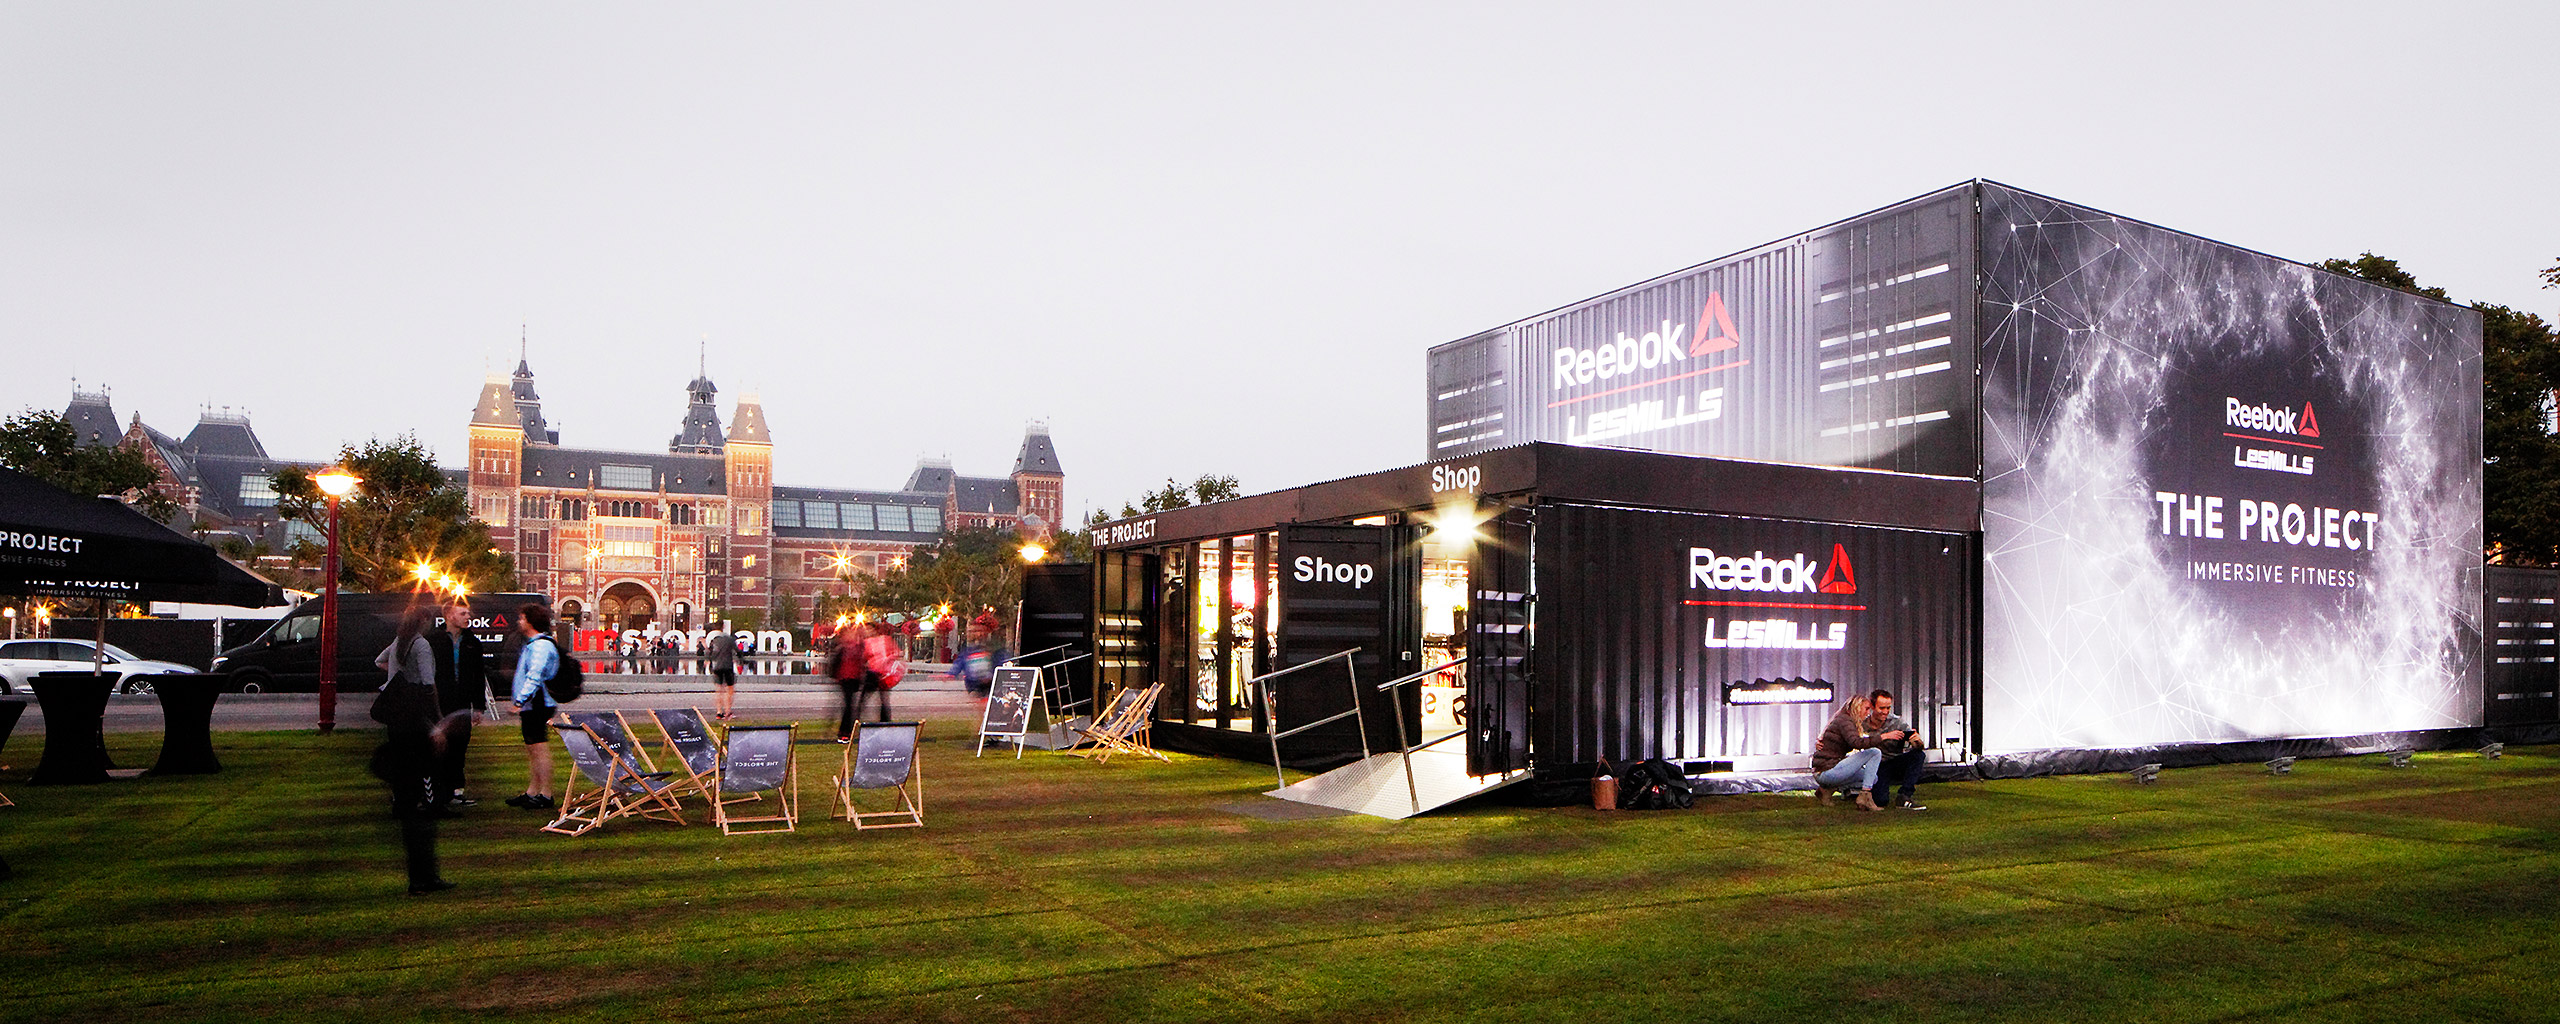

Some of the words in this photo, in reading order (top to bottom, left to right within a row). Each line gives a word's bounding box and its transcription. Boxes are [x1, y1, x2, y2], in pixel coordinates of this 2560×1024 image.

[1553, 319, 1687, 390] Reebok
[2226, 397, 2298, 435] Reebok
[1431, 464, 1480, 494] Shop
[2155, 491, 2224, 539] THE
[1091, 527, 1109, 547] THE
[1293, 555, 1374, 589] Shop
[1689, 547, 1818, 593] Reebok
[2187, 561, 2283, 583] IMMERSIVE
[2291, 566, 2355, 588] FITNESS
[435, 616, 490, 628] Rok
